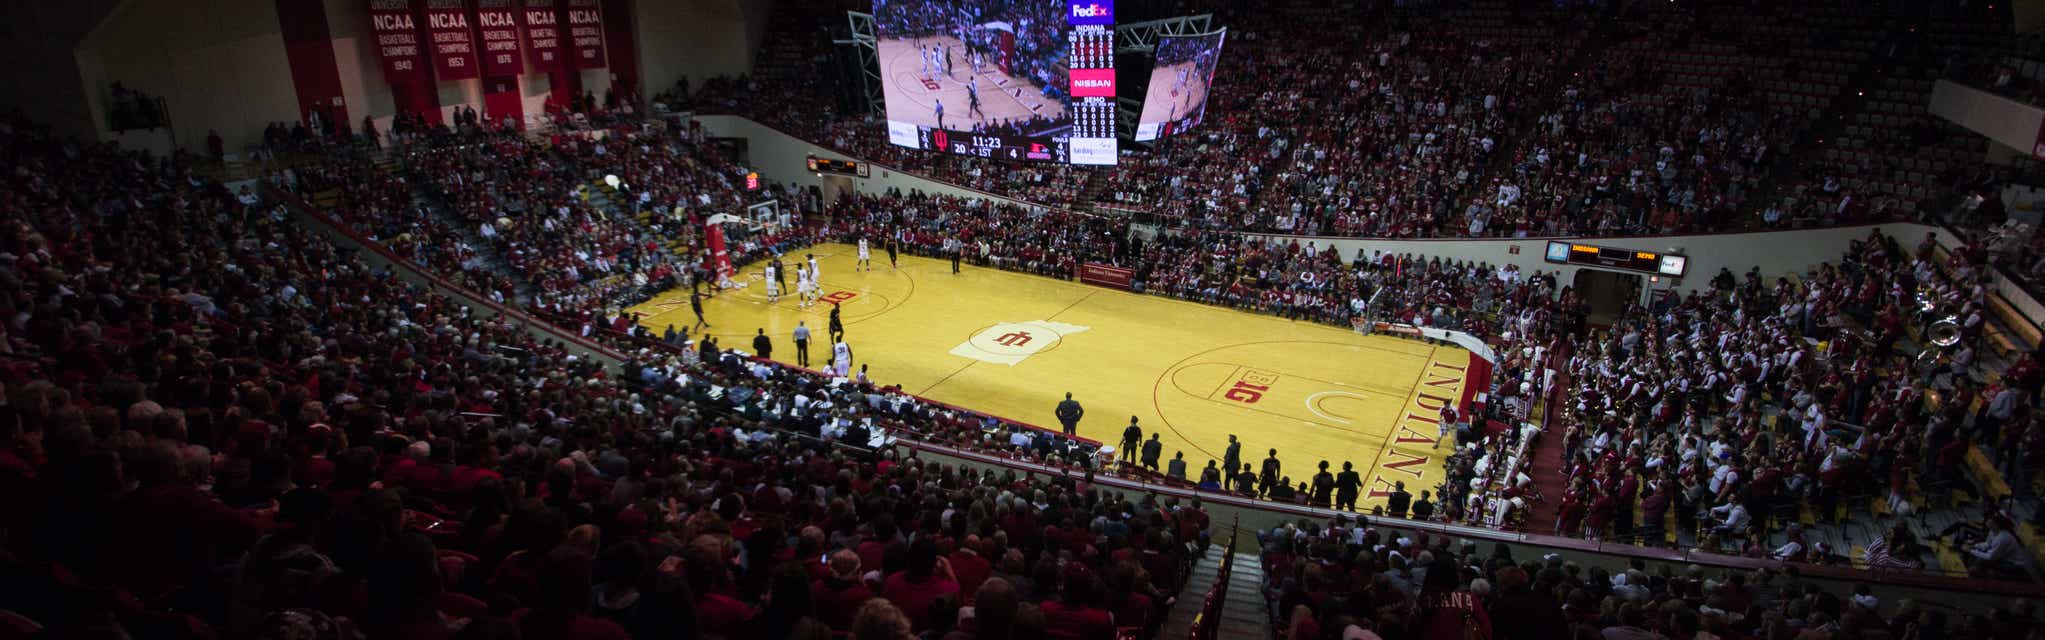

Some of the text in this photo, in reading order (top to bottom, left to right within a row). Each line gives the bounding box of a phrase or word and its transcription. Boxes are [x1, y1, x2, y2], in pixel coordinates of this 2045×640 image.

[568, 9, 600, 24] NCAA
[1073, 4, 1107, 17] FedEx
[373, 14, 416, 30] NCAA
[429, 13, 467, 29] NCAA
[480, 11, 515, 27] NCAA
[526, 10, 557, 25] NCAA
[379, 34, 417, 45] BASKETBALL
[382, 45, 417, 56] CHAMPIONS
[954, 142, 966, 154] 20
[972, 136, 1001, 149] 11:23
[978, 148, 992, 157] 1ST
[1009, 148, 1017, 158] 4
